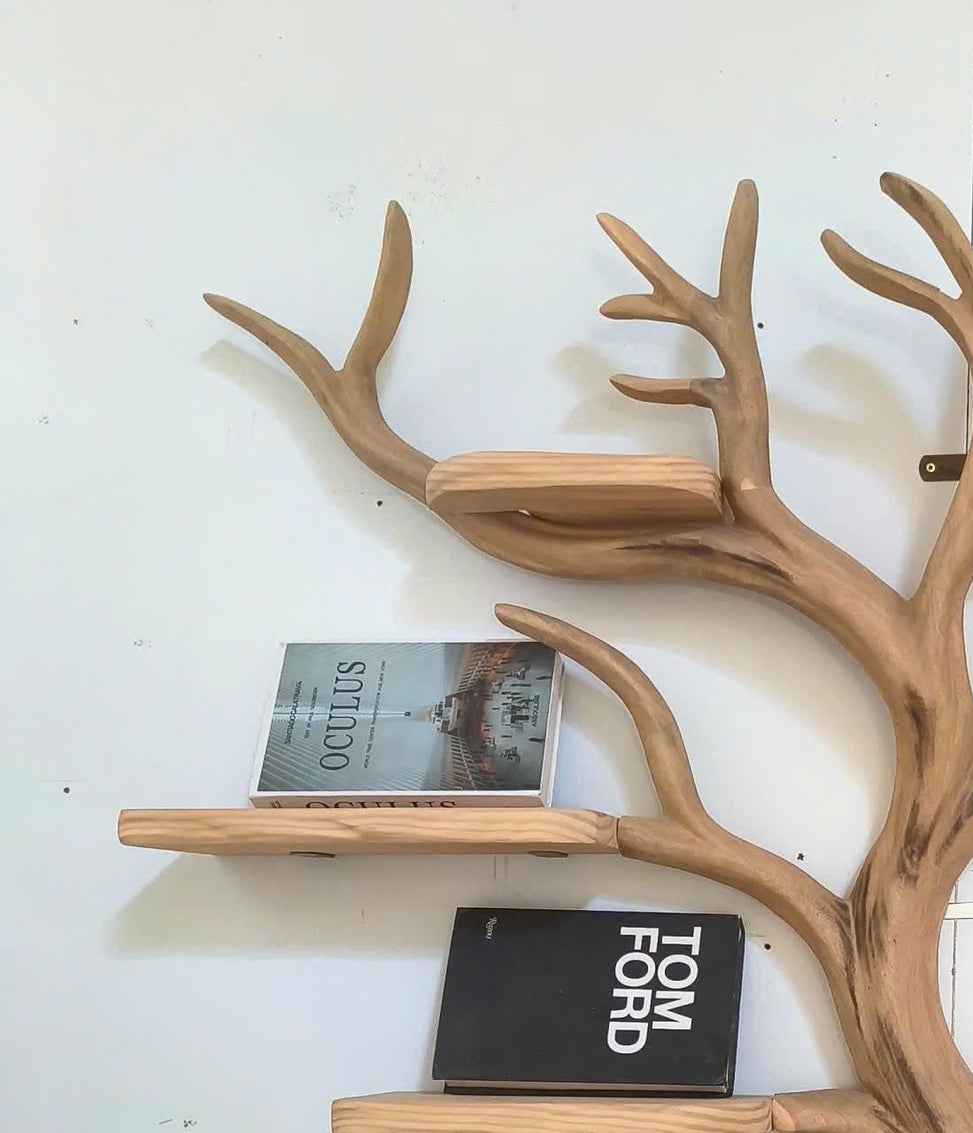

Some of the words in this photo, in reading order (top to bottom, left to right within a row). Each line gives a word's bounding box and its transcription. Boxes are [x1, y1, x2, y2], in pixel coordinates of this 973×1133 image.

[319, 660, 366, 771] OCULUS
[607, 926, 659, 1055] FORD
[652, 926, 702, 1031] TOM
